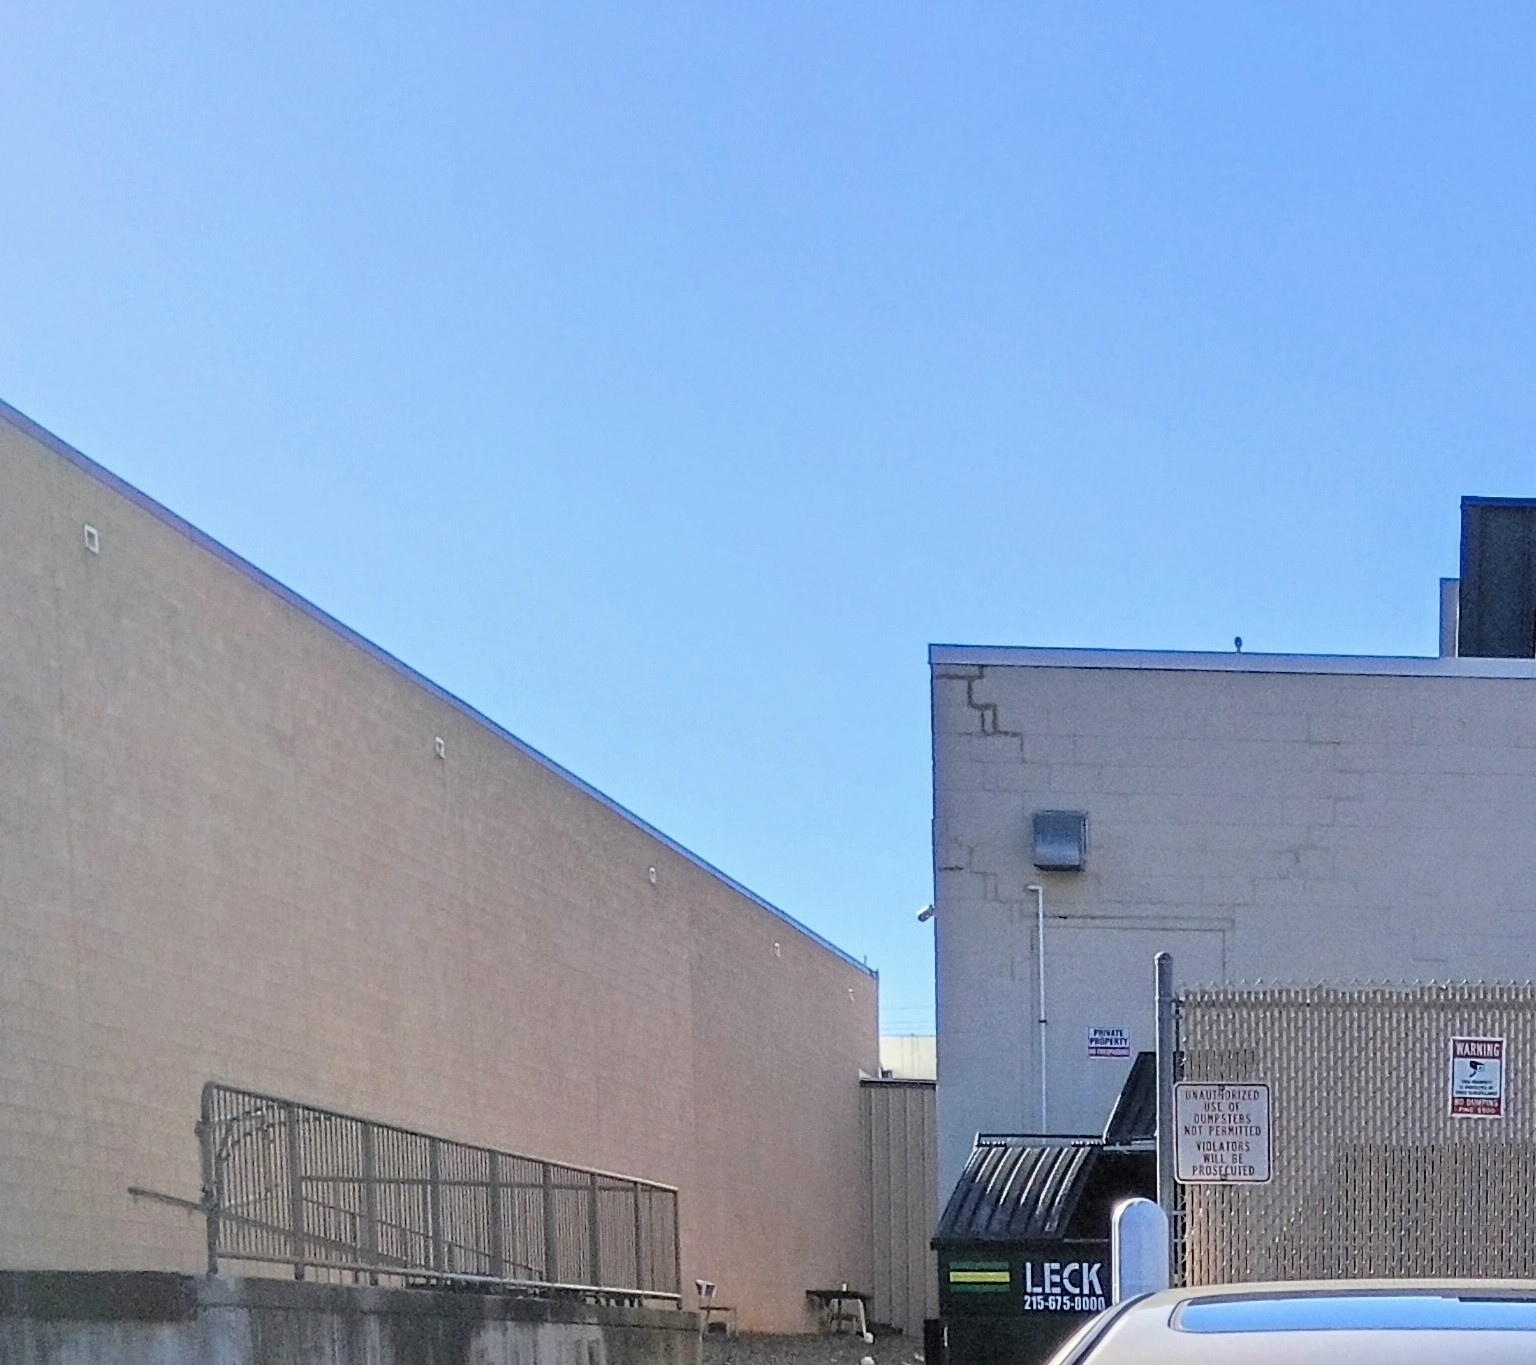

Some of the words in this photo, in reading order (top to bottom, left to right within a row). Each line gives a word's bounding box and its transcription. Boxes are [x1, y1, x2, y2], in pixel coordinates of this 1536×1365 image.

[1093, 1029, 1123, 1037] PRIVATE
[1089, 1037, 1128, 1046] PROPERTY
[1455, 1042, 1501, 1057] WARNING
[1185, 1089, 1260, 1101] UNAUTHORIZED
[1204, 1101, 1223, 1112] USE
[1228, 1101, 1240, 1112] OF
[1194, 1113, 1252, 1124] DUMPSTERS
[1184, 1125, 1203, 1136] NOT
[1208, 1125, 1262, 1136] PERMITTED
[1196, 1141, 1251, 1152] VIOLATORS
[1203, 1153, 1226, 1164] WILL
[1231, 1153, 1243, 1164] BE
[1192, 1165, 1255, 1176] PROSECUTED
[1025, 1262, 1103, 1294] LECK
